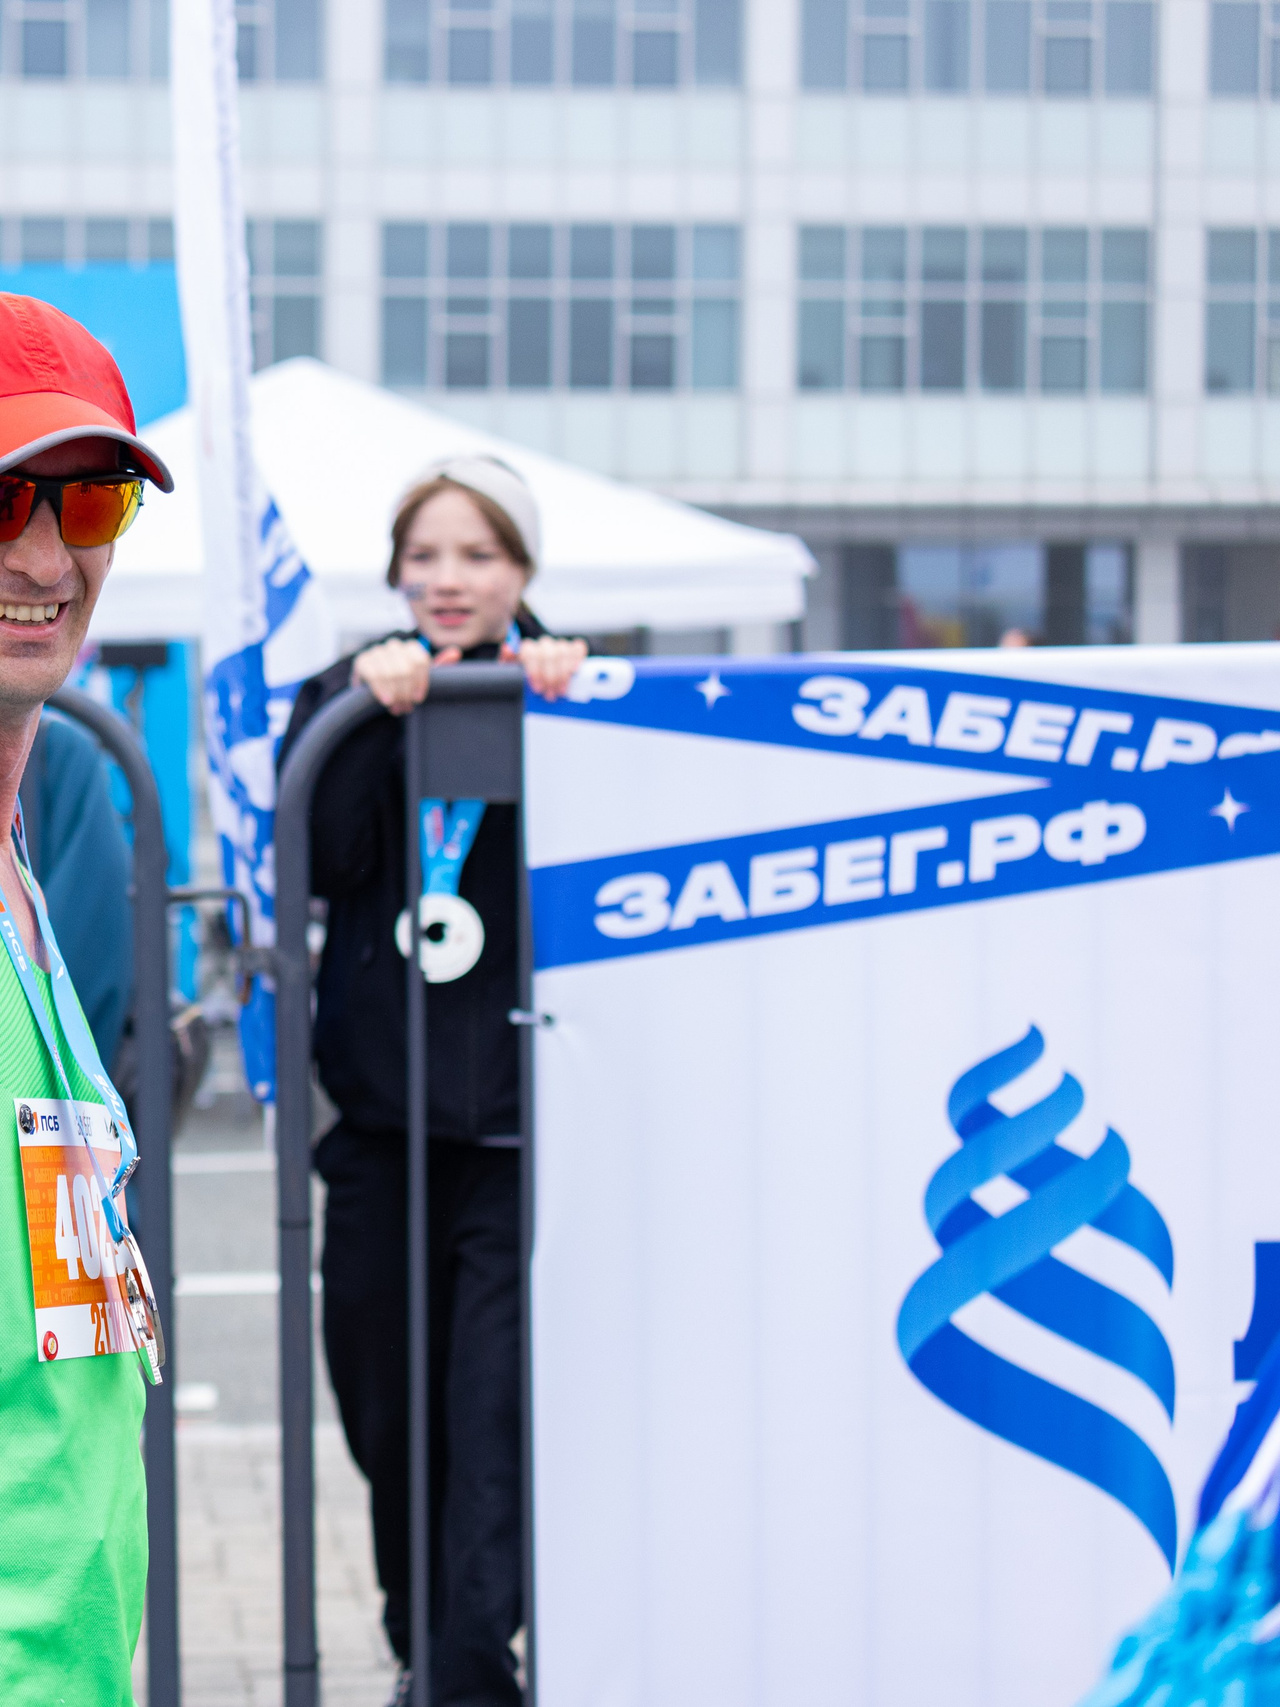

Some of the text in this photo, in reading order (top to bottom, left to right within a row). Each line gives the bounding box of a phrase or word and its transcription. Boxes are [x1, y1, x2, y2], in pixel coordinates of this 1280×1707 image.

[594, 799, 1146, 939] ЗАБЕГ.РФ
[2, 920, 27, 972] ПСБ
[93, 1073, 124, 1118] ПСБ
[40, 1115, 60, 1132] ПСБ
